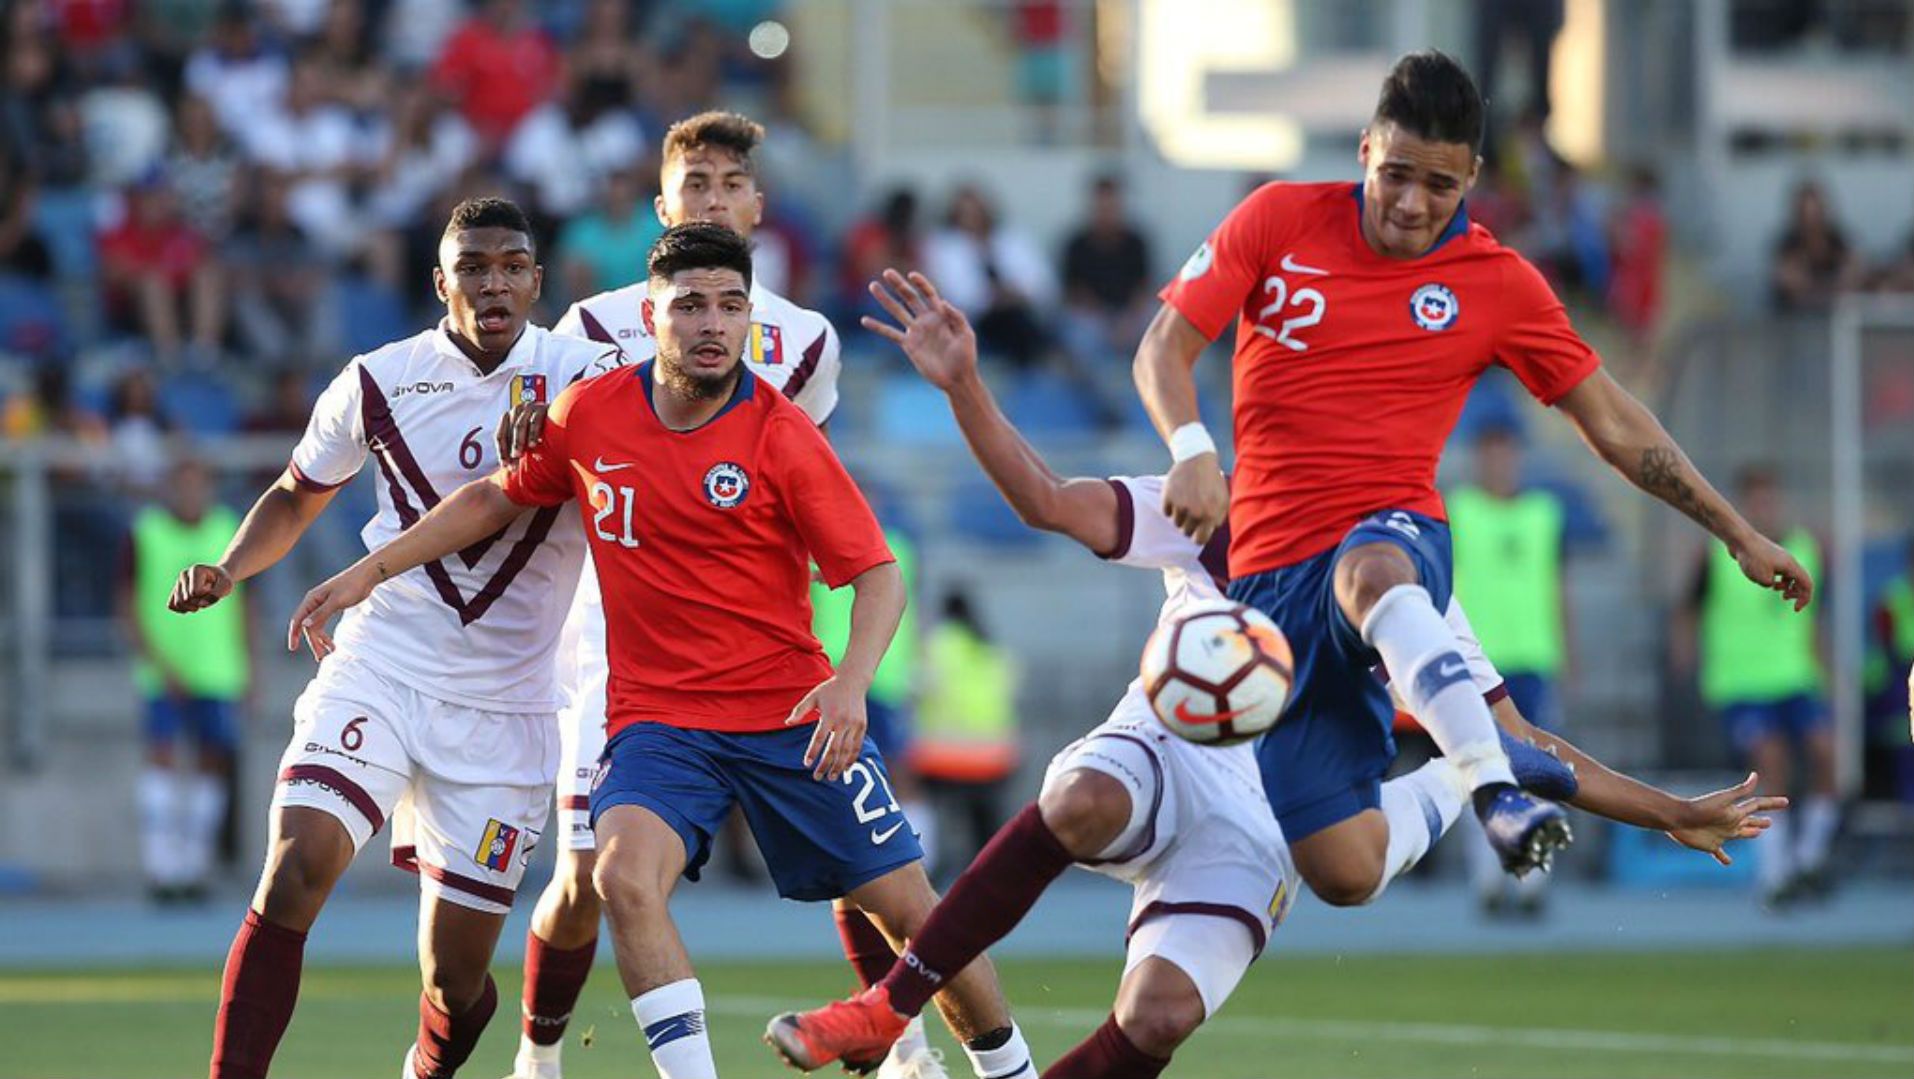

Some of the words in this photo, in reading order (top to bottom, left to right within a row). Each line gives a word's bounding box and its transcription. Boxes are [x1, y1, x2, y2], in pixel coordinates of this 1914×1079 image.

[1255, 275, 1325, 351] 22
[459, 425, 484, 470] 6
[593, 481, 640, 548] 21
[340, 716, 368, 751] 6
[843, 757, 901, 824] 21
